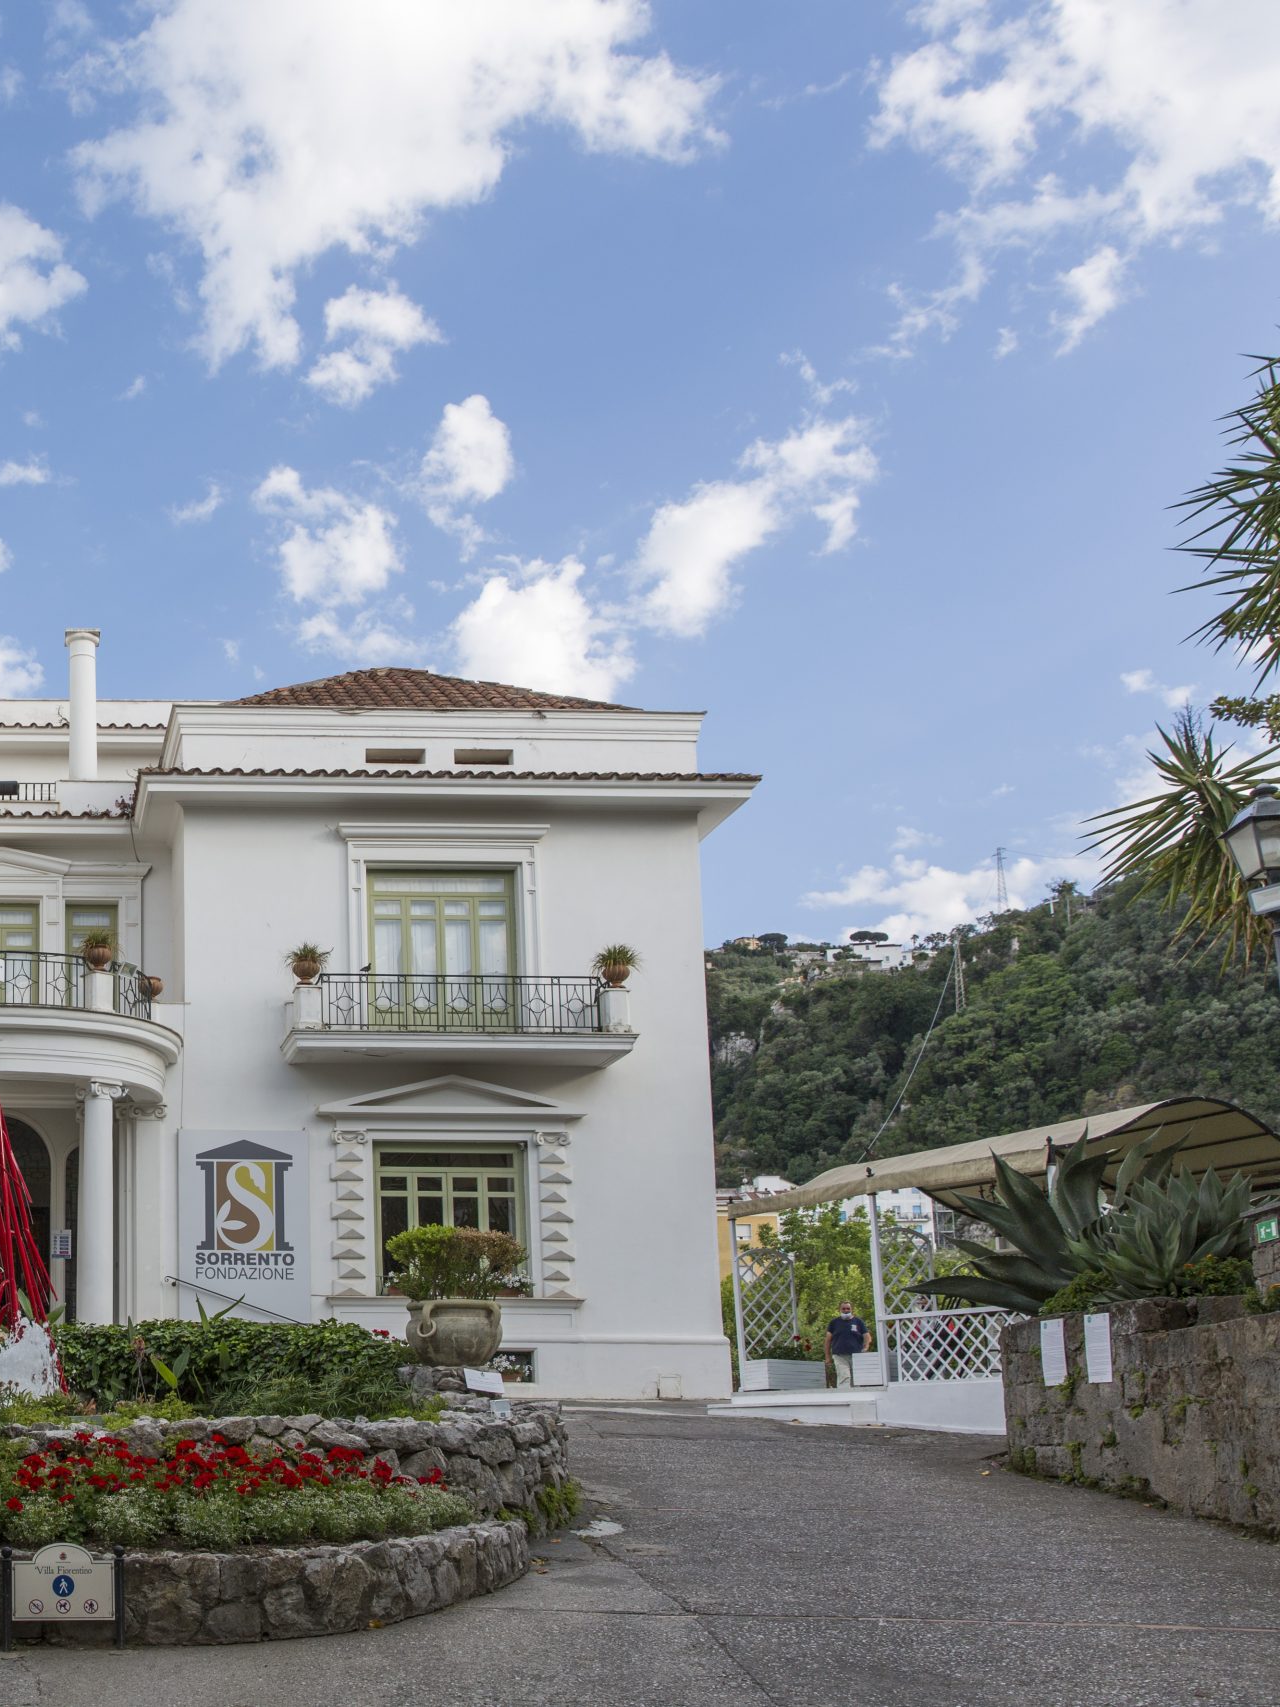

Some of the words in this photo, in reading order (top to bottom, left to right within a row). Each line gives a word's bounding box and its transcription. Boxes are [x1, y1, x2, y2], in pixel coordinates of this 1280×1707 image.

[195, 1252, 295, 1266] SORRENTO
[195, 1266, 295, 1281] FONDAZIONE
[35, 1565, 54, 1575] Villa
[57, 1565, 92, 1575] Fiorentino
